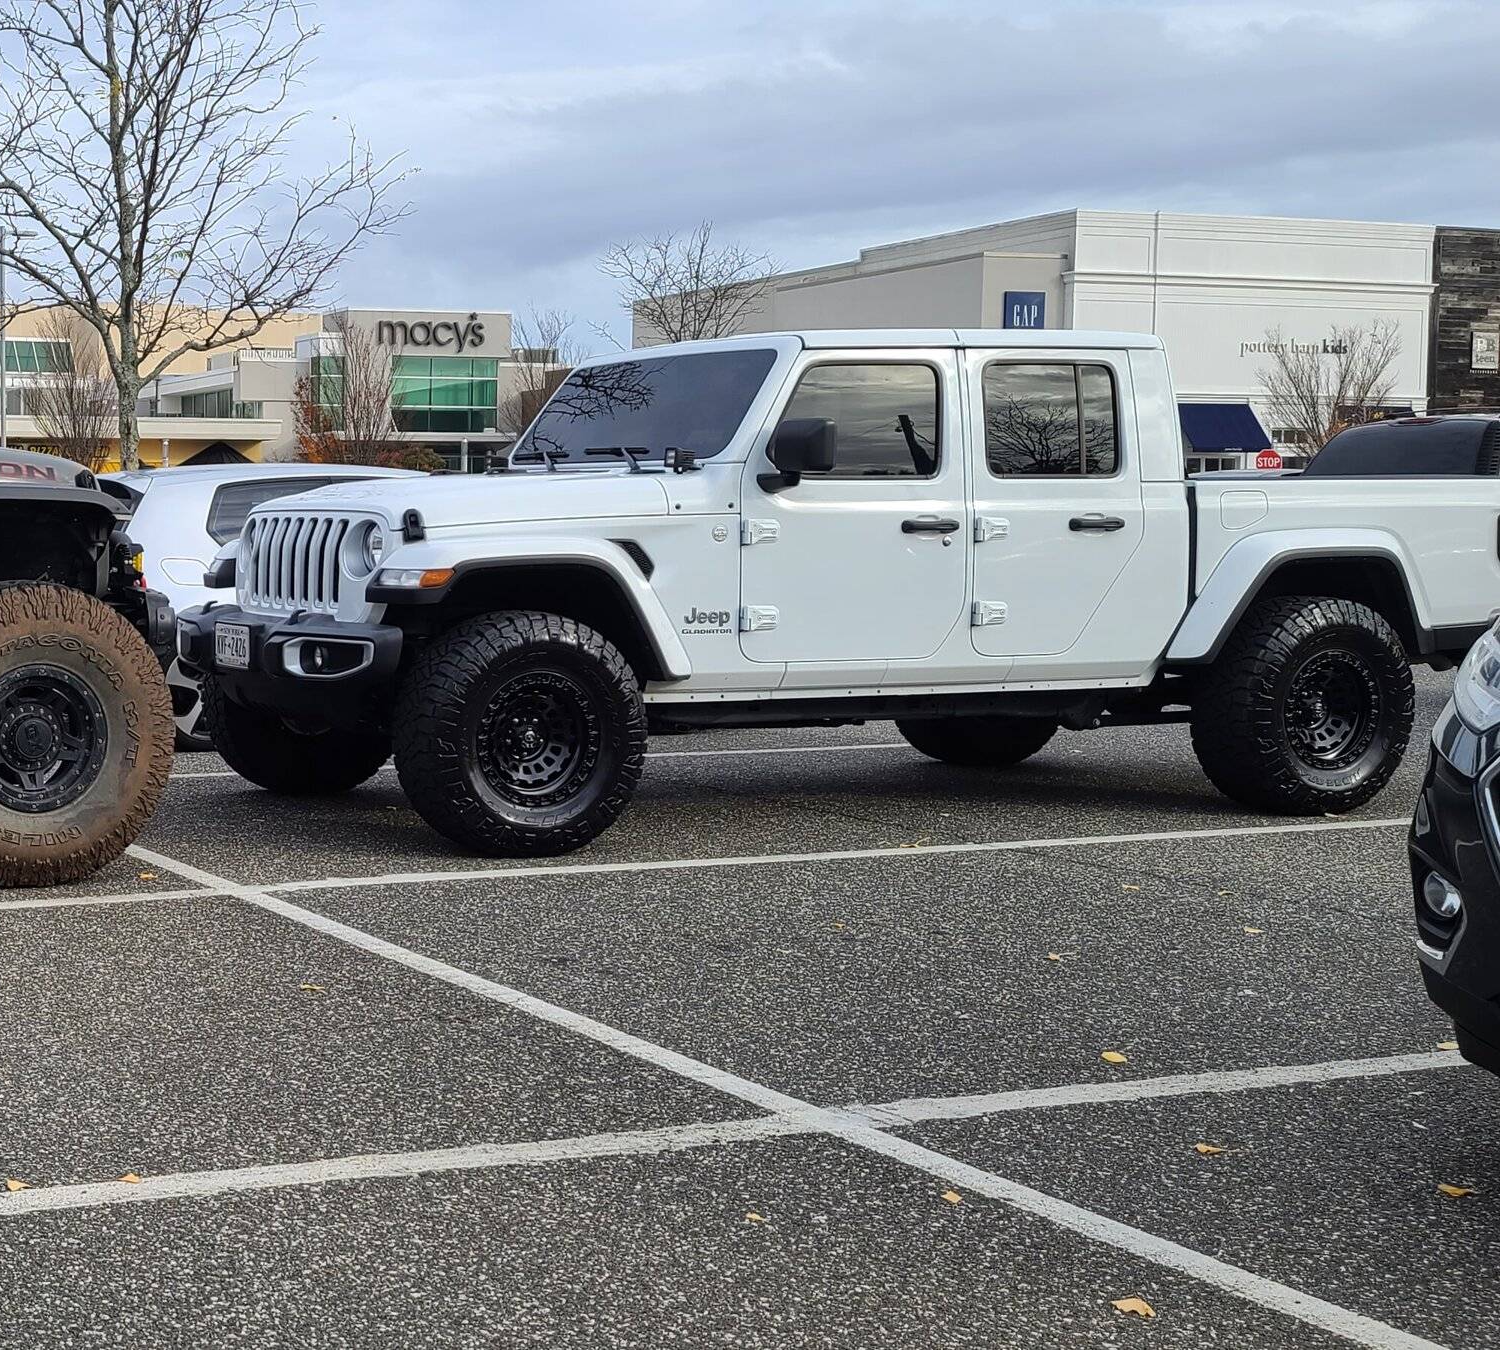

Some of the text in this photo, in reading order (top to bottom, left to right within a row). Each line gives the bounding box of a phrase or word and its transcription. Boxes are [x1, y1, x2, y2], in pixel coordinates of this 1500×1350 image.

[1013, 304, 1038, 327] GAP
[1240, 341, 1287, 358] pottery
[1322, 338, 1348, 354] kids
[1257, 457, 1280, 467] STOP
[683, 607, 730, 627] Jeep
[122, 701, 141, 768] M/T
